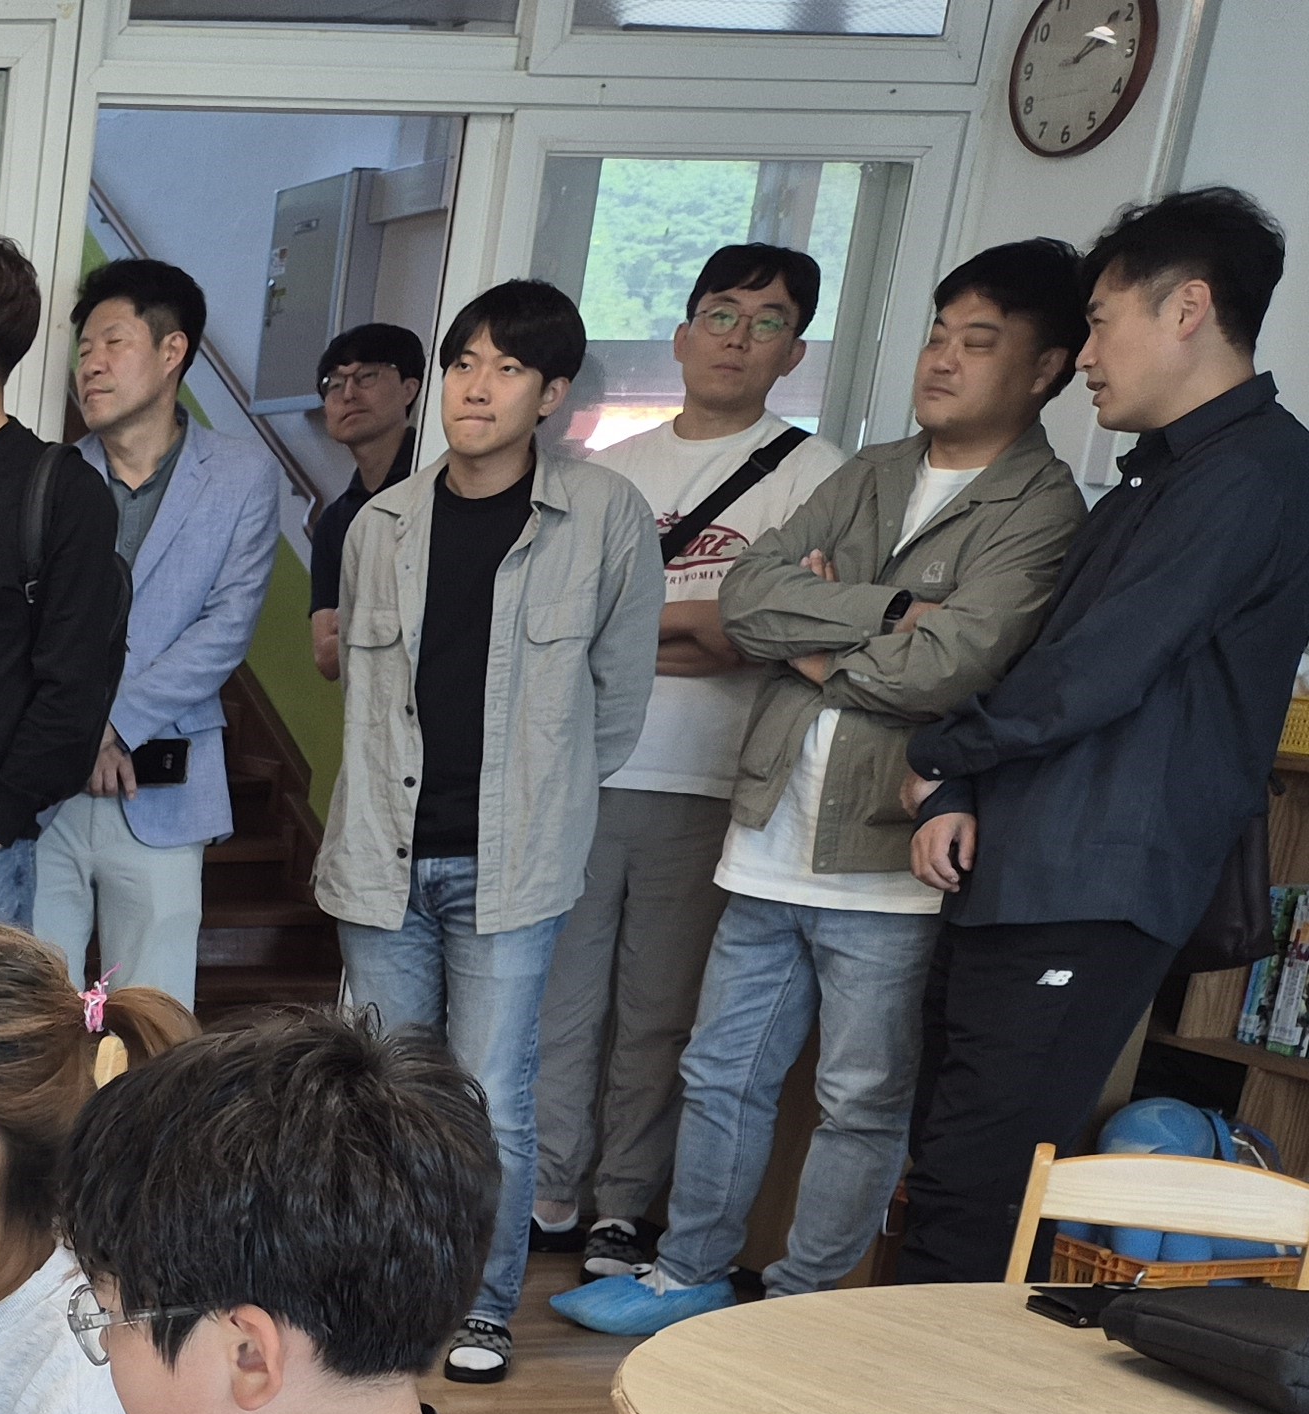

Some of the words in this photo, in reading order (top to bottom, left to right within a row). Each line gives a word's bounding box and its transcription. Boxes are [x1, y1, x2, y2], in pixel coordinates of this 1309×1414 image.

[1124, 3, 1134, 22] 2
[1033, 23, 1051, 43] 10
[1124, 38, 1136, 58] 3
[1023, 62, 1034, 81] 9
[1111, 76, 1123, 95] 4
[1023, 96, 1034, 115] 8
[1038, 121, 1048, 139] 7
[1086, 111, 1097, 130] 5
[1060, 125, 1071, 144] 6
